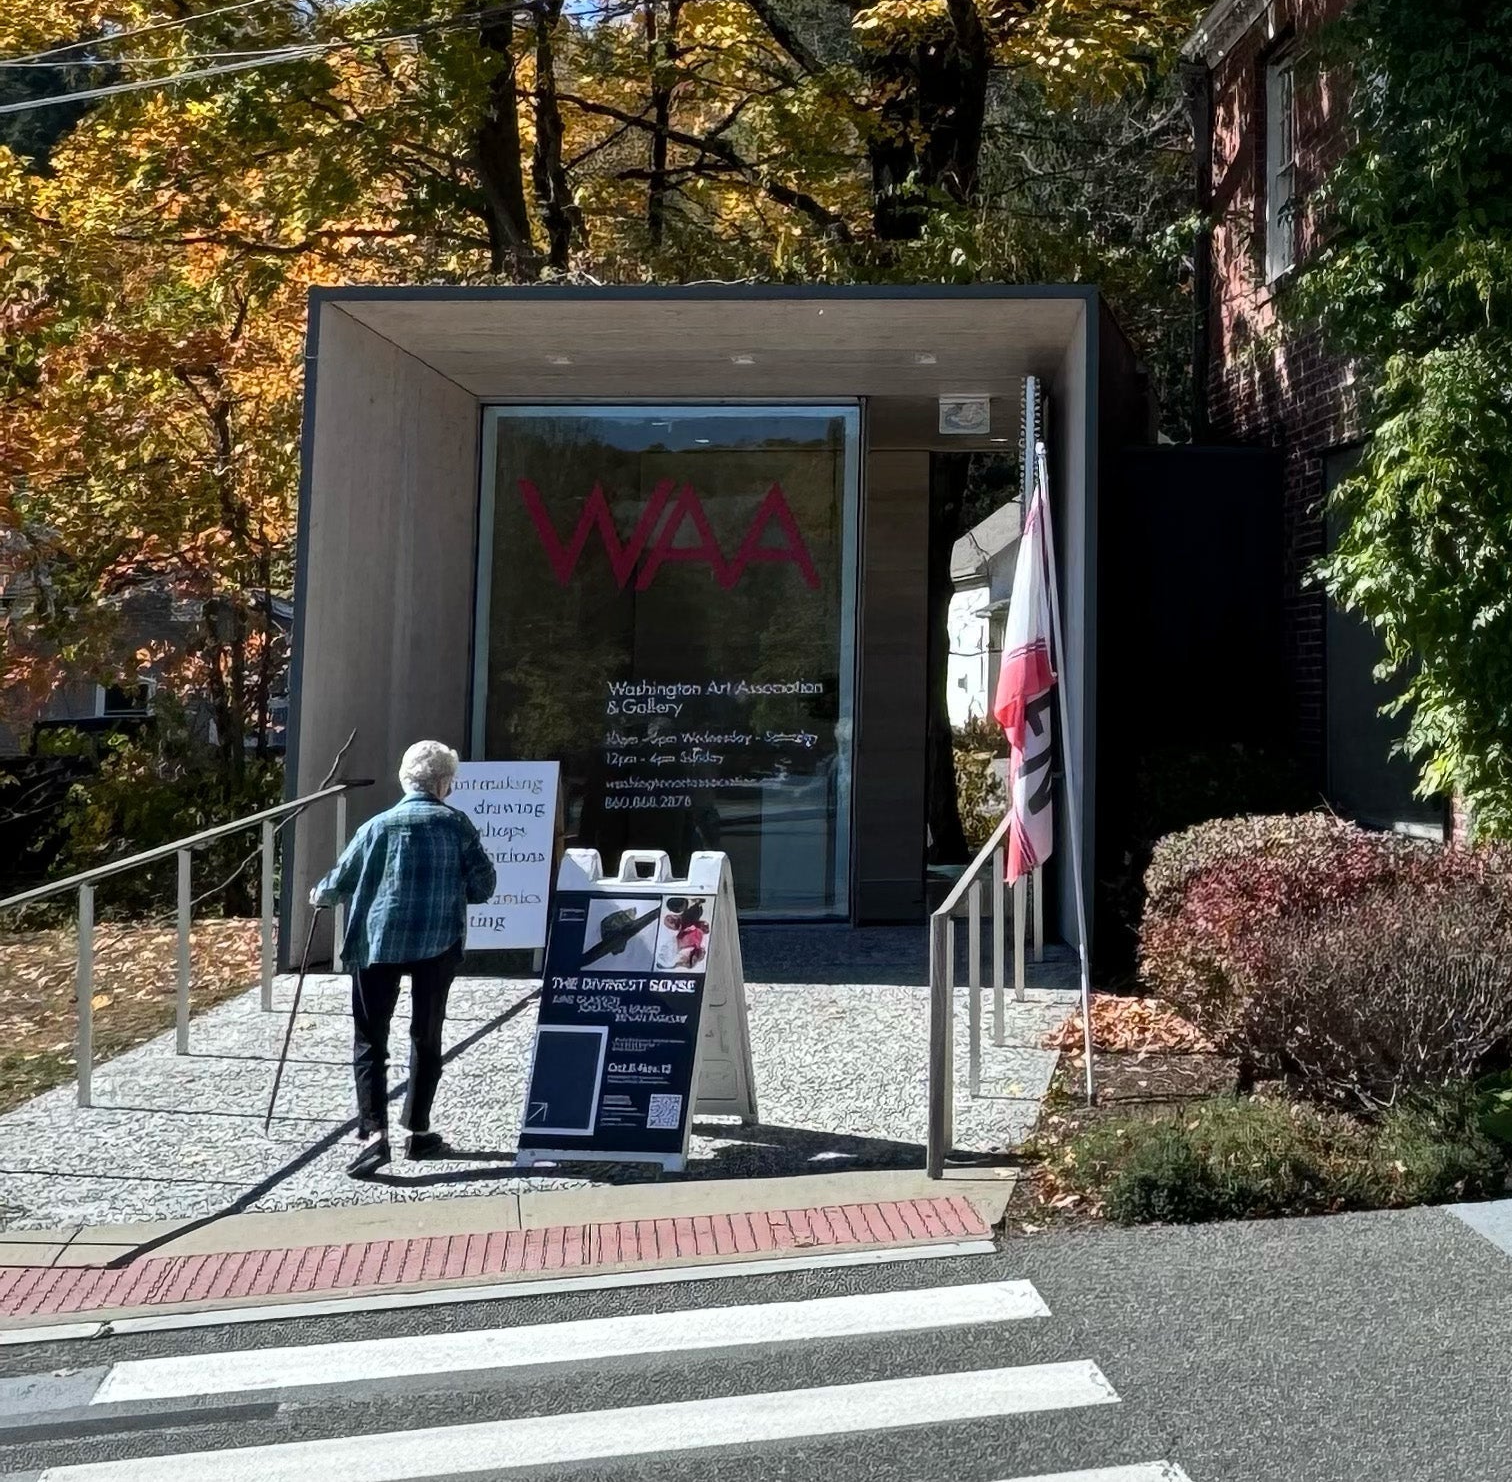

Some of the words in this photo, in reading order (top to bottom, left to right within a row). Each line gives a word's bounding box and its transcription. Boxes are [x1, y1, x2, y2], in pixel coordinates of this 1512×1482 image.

[517, 478, 822, 592] WAA
[606, 680, 701, 699] Washington
[705, 680, 731, 695] Art
[734, 679, 824, 695] Association
[606, 700, 619, 715] &
[622, 698, 684, 717] Gallery
